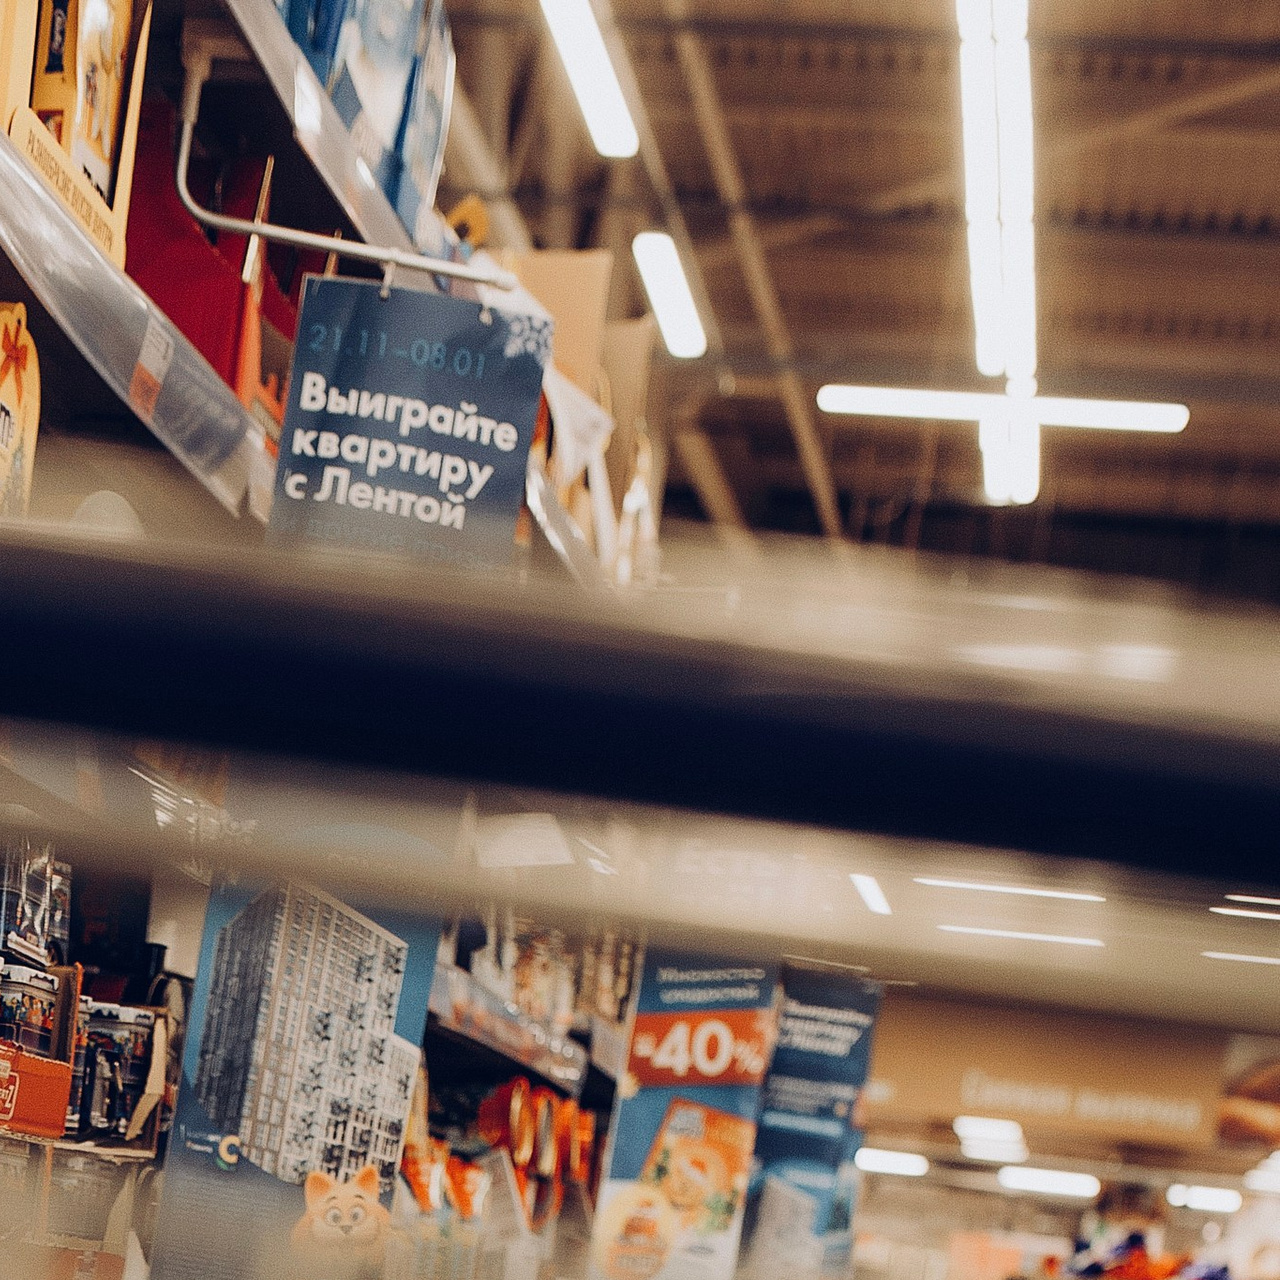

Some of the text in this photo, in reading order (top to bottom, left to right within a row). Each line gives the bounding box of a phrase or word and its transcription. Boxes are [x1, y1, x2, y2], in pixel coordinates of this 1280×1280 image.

[299, 371, 518, 451] Выиграйте
[284, 465, 467, 531] с Лентой
[291, 428, 494, 500] квартиру
